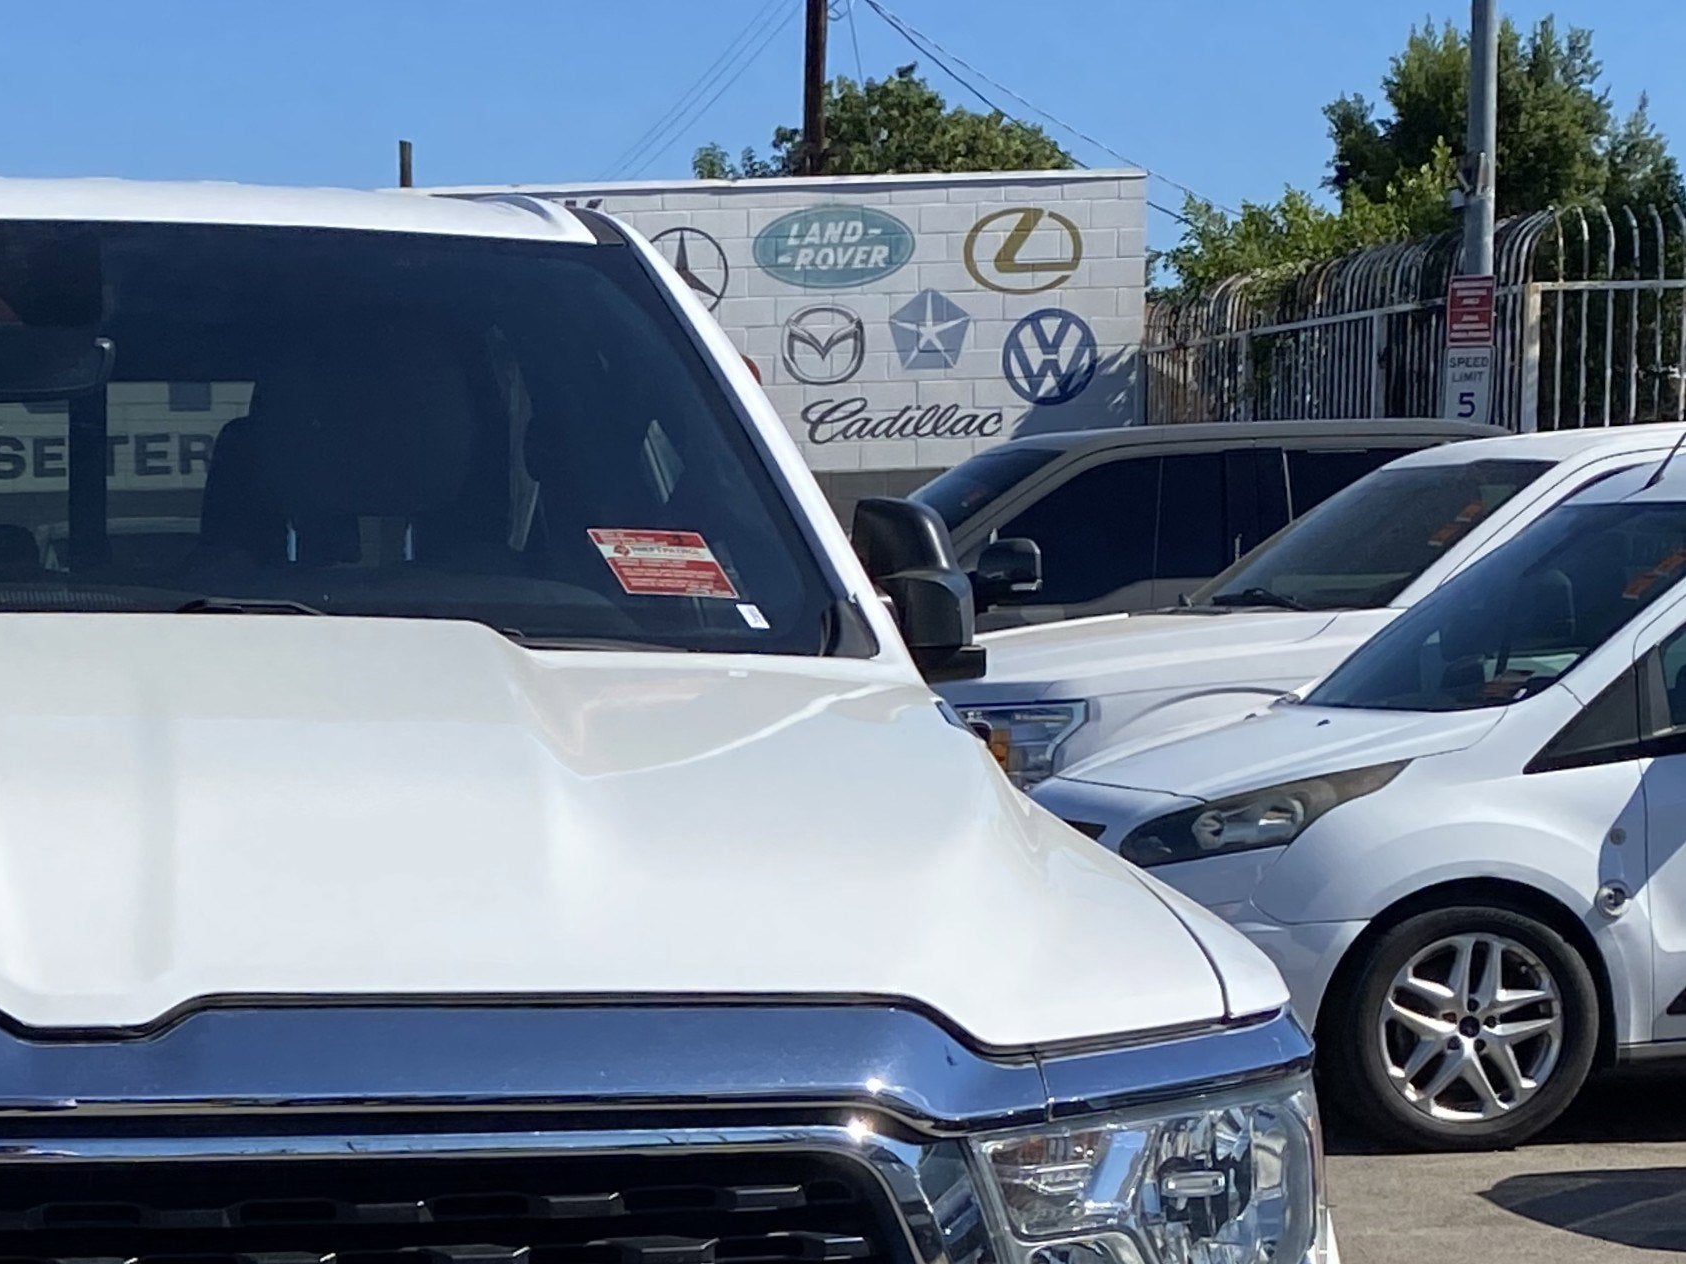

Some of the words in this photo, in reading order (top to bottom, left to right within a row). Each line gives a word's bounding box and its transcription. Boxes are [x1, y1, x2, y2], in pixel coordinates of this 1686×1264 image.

[1449, 356, 1489, 368] SPEED
[1452, 371, 1484, 383] LIMIT
[1457, 392, 1476, 418] 5
[801, 397, 1003, 445] Cadillac
